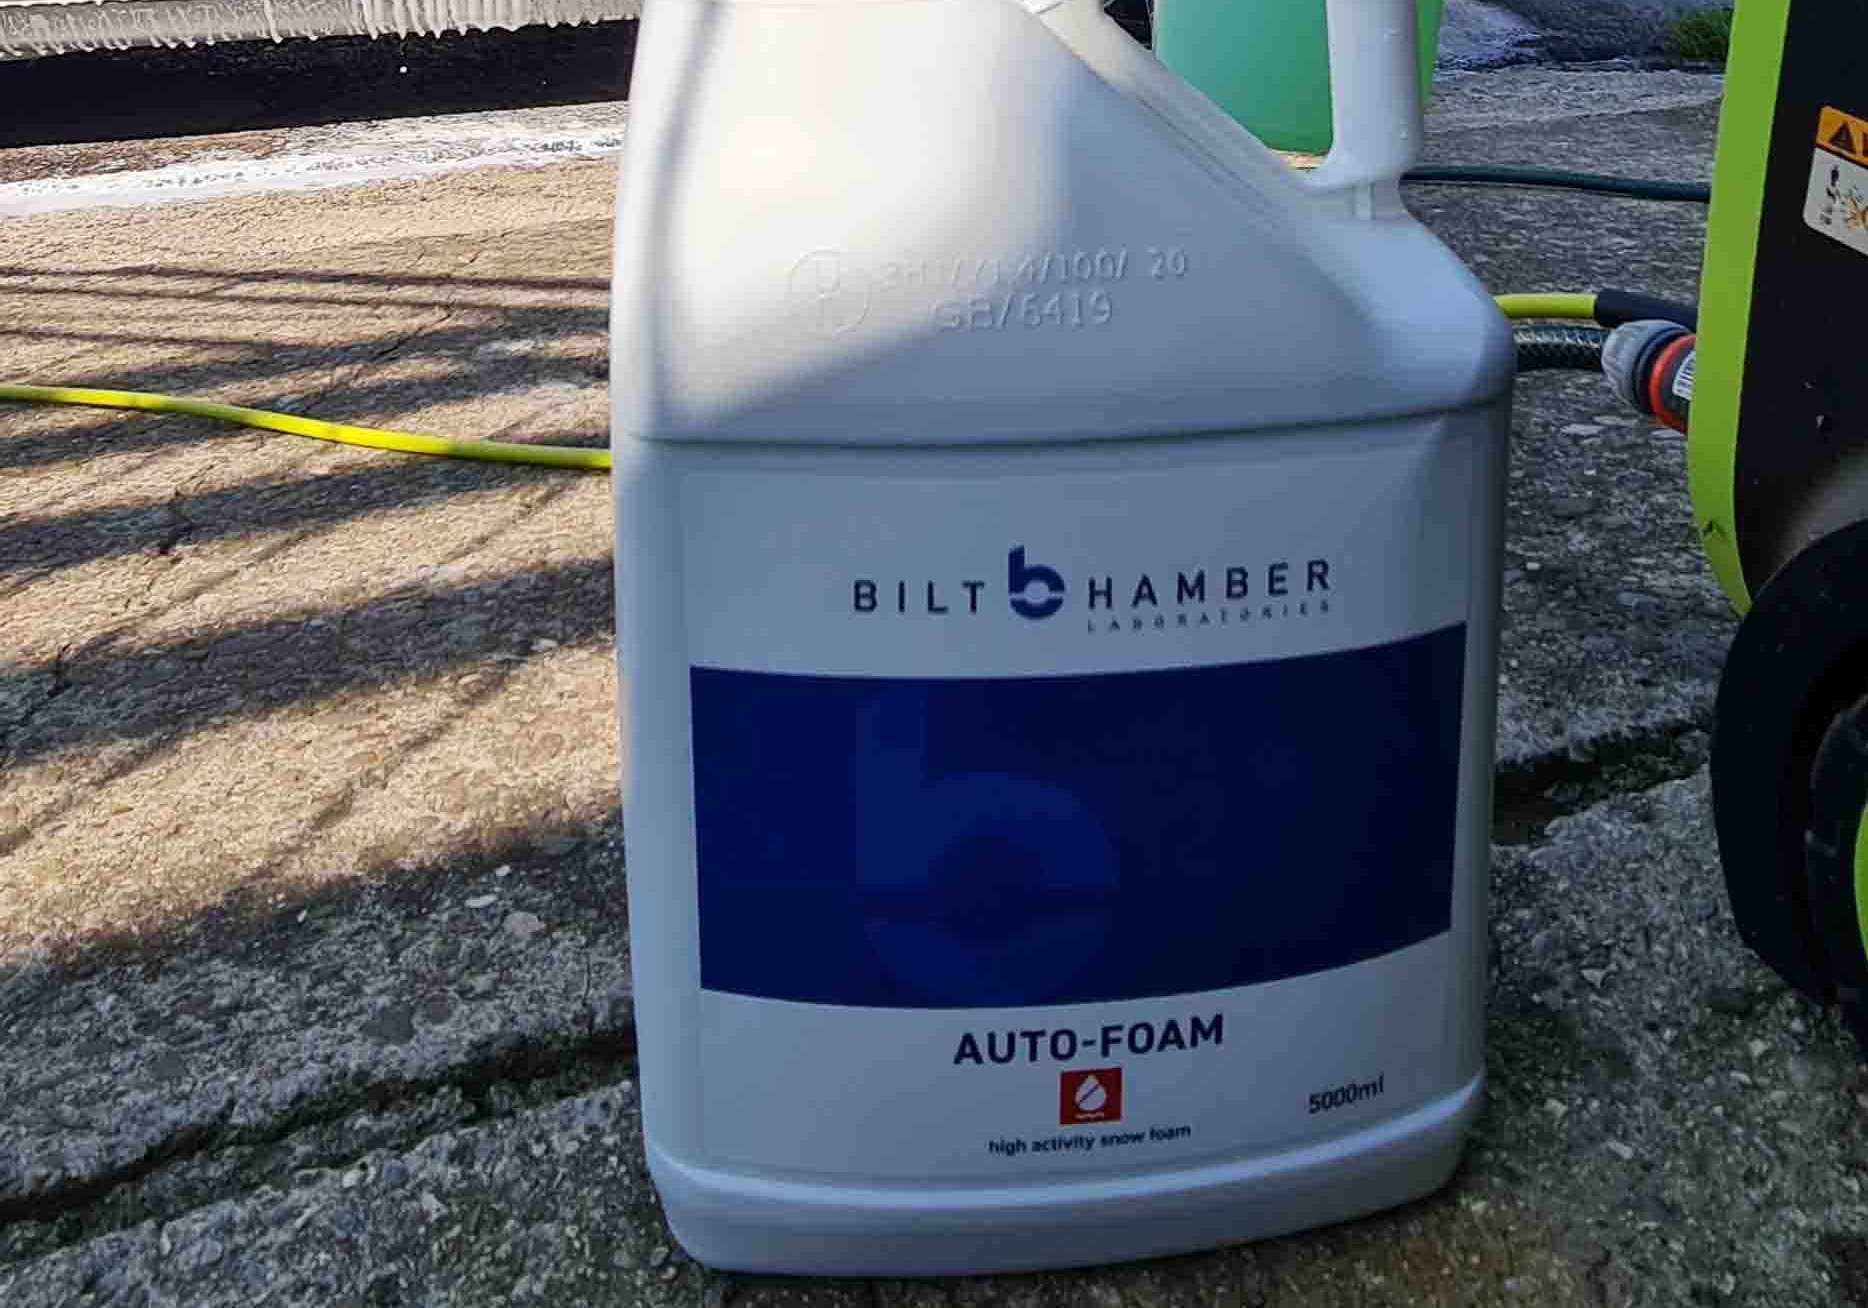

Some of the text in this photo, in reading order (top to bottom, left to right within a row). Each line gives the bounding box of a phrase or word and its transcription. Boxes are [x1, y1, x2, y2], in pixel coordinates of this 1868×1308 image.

[853, 579, 986, 614] BILT
[1087, 559, 1331, 609] HAMBER
[1086, 599, 1332, 634] LABORATORIES
[952, 1012, 1226, 1066] AUTO-FOAM
[1307, 1073, 1386, 1115] 5000ml
[987, 1125, 1192, 1157] high activity snow foam
